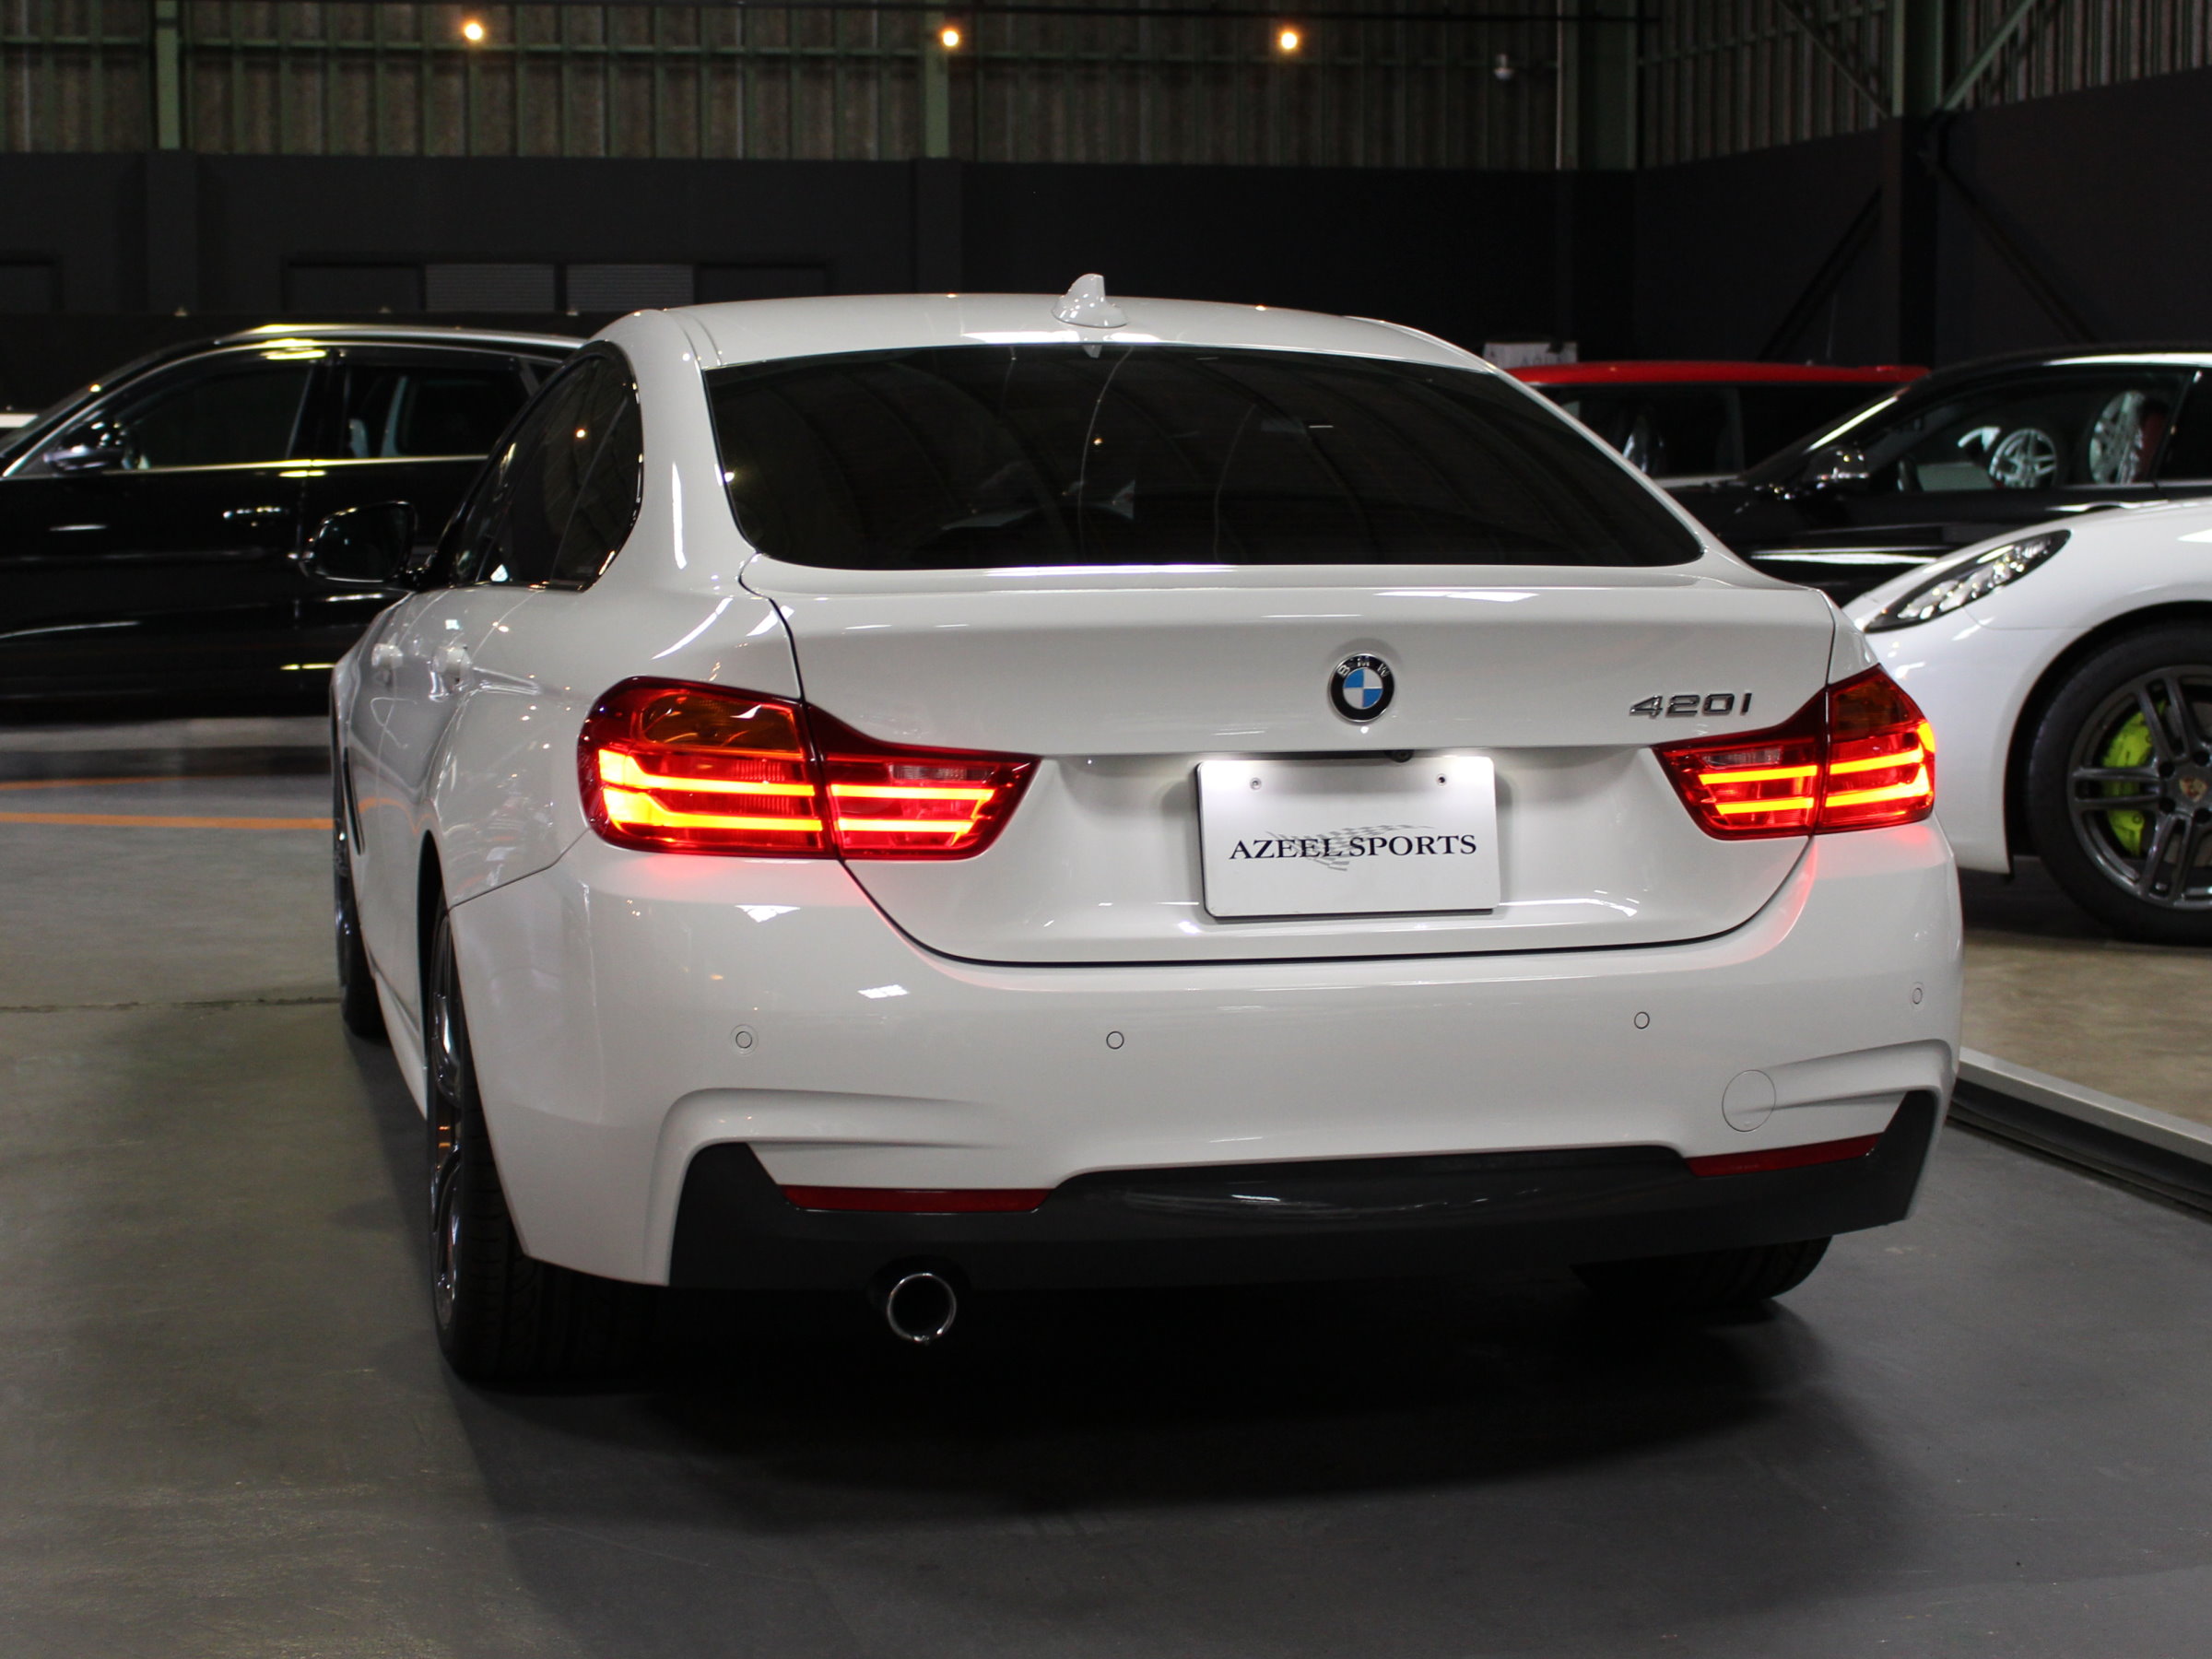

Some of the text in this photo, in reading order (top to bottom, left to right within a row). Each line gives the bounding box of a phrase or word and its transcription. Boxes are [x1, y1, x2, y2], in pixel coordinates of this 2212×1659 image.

[1336, 655, 1391, 678] BMW
[1229, 834, 1477, 860] AZEEL SPORTS
